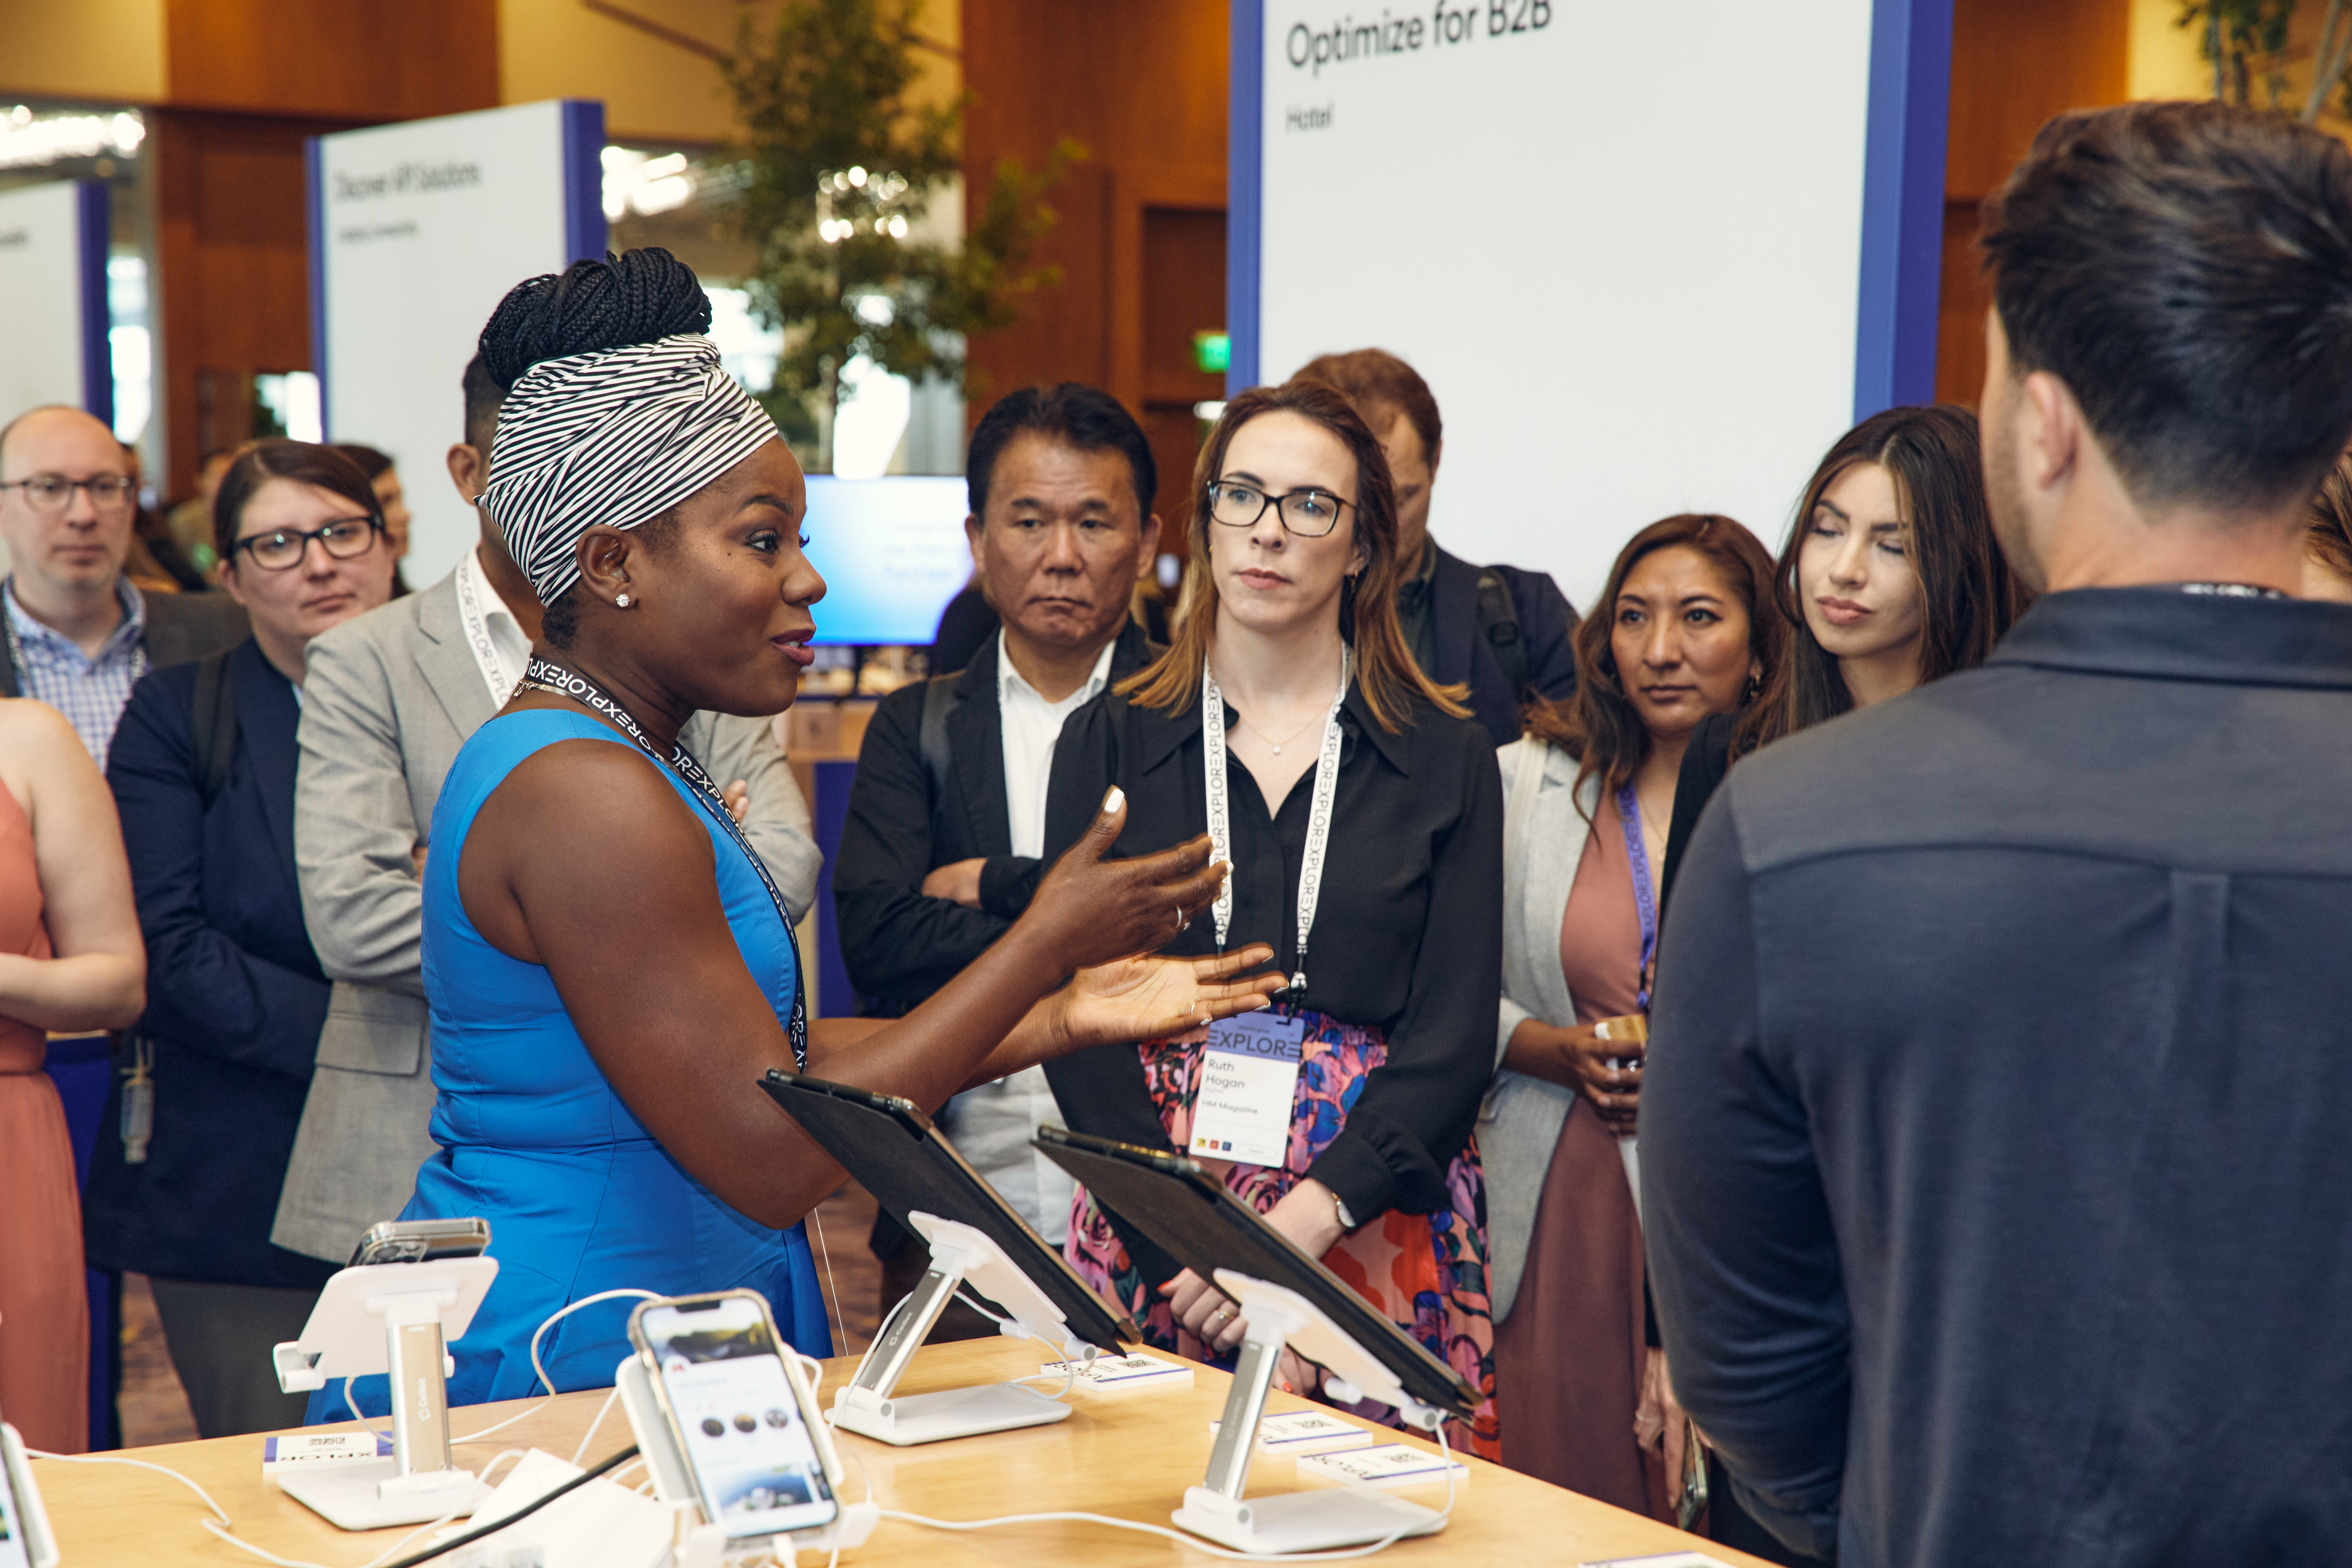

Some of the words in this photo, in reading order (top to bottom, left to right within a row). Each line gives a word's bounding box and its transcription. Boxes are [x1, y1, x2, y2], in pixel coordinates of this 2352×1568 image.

[1286, 9, 1424, 77] Optimize
[1433, 0, 1476, 46] for
[1487, 0, 1552, 37] B2B
[1286, 102, 1334, 132] Hotel
[1208, 1059, 1234, 1071] Ruth
[1205, 1073, 1245, 1088] Hogan
